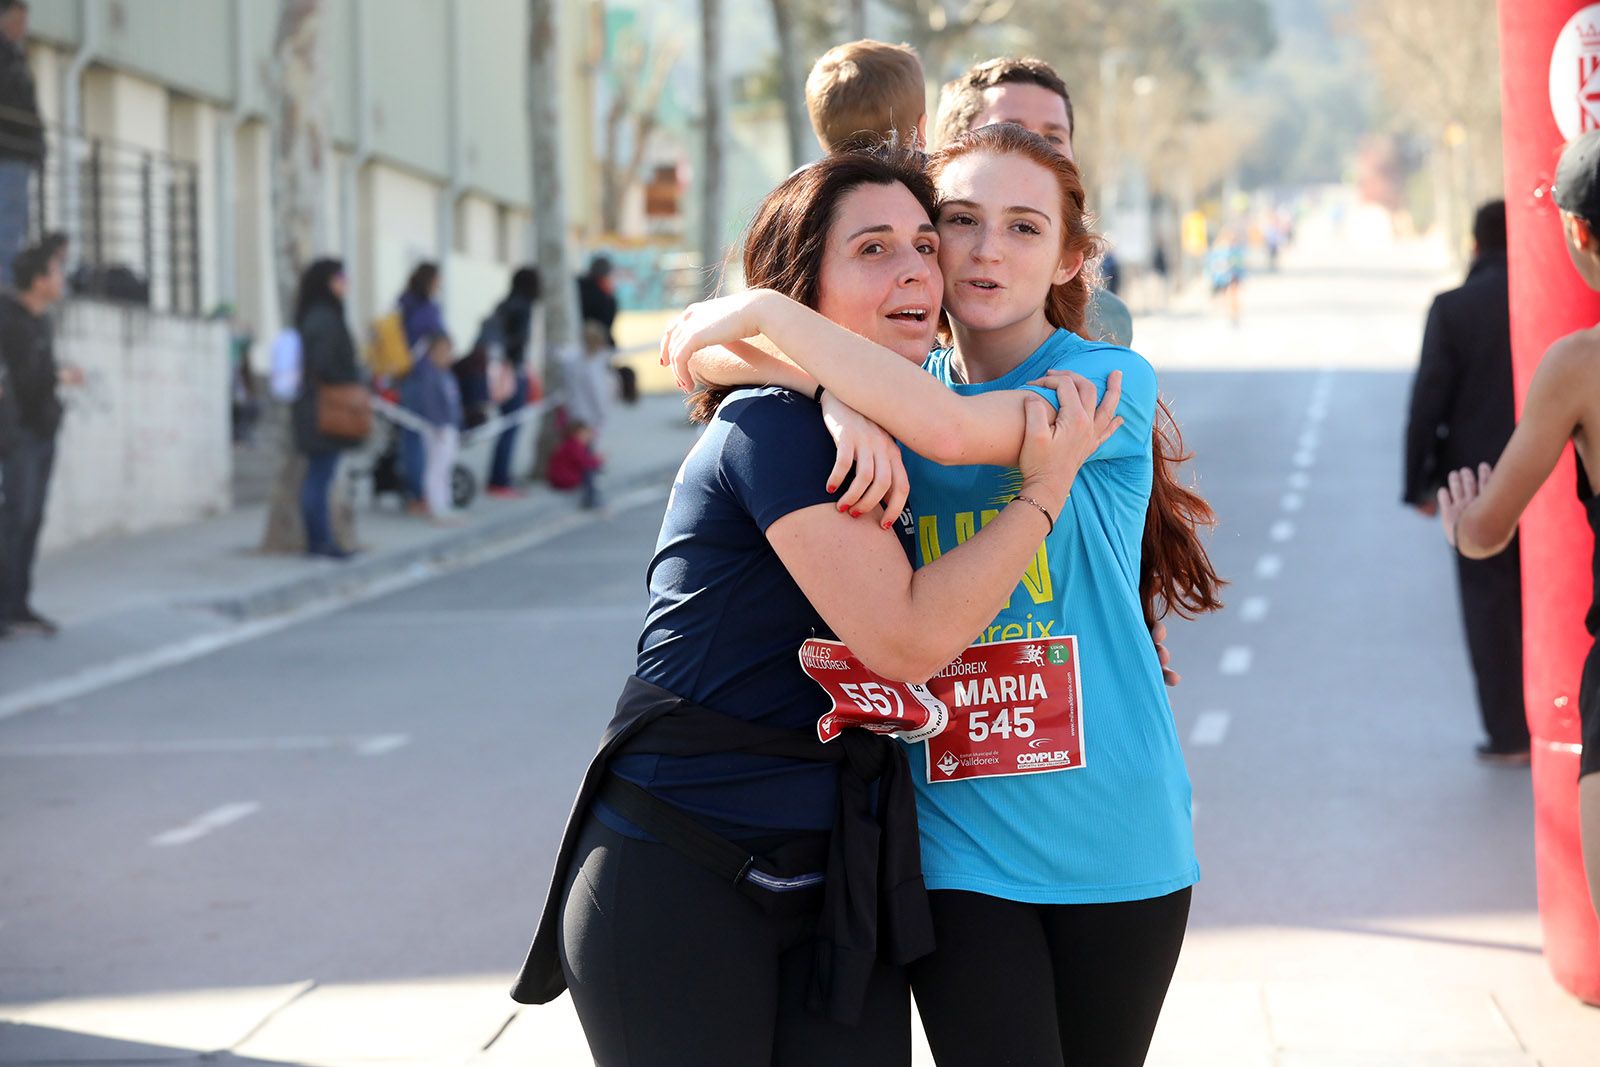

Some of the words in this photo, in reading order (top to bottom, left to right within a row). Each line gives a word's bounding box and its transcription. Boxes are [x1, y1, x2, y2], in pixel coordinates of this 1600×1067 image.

[979, 613, 1055, 644] reix
[802, 645, 831, 660] MILLES
[1054, 650, 1060, 659] 1
[803, 657, 851, 670] VALLDOREIX
[931, 661, 987, 679] ALLDOREIX
[954, 673, 1048, 708] MARIA
[838, 682, 904, 718] 557
[968, 706, 1036, 743] 545
[960, 755, 1000, 767] Valldoreix
[1016, 750, 1070, 764] COMPLEX
